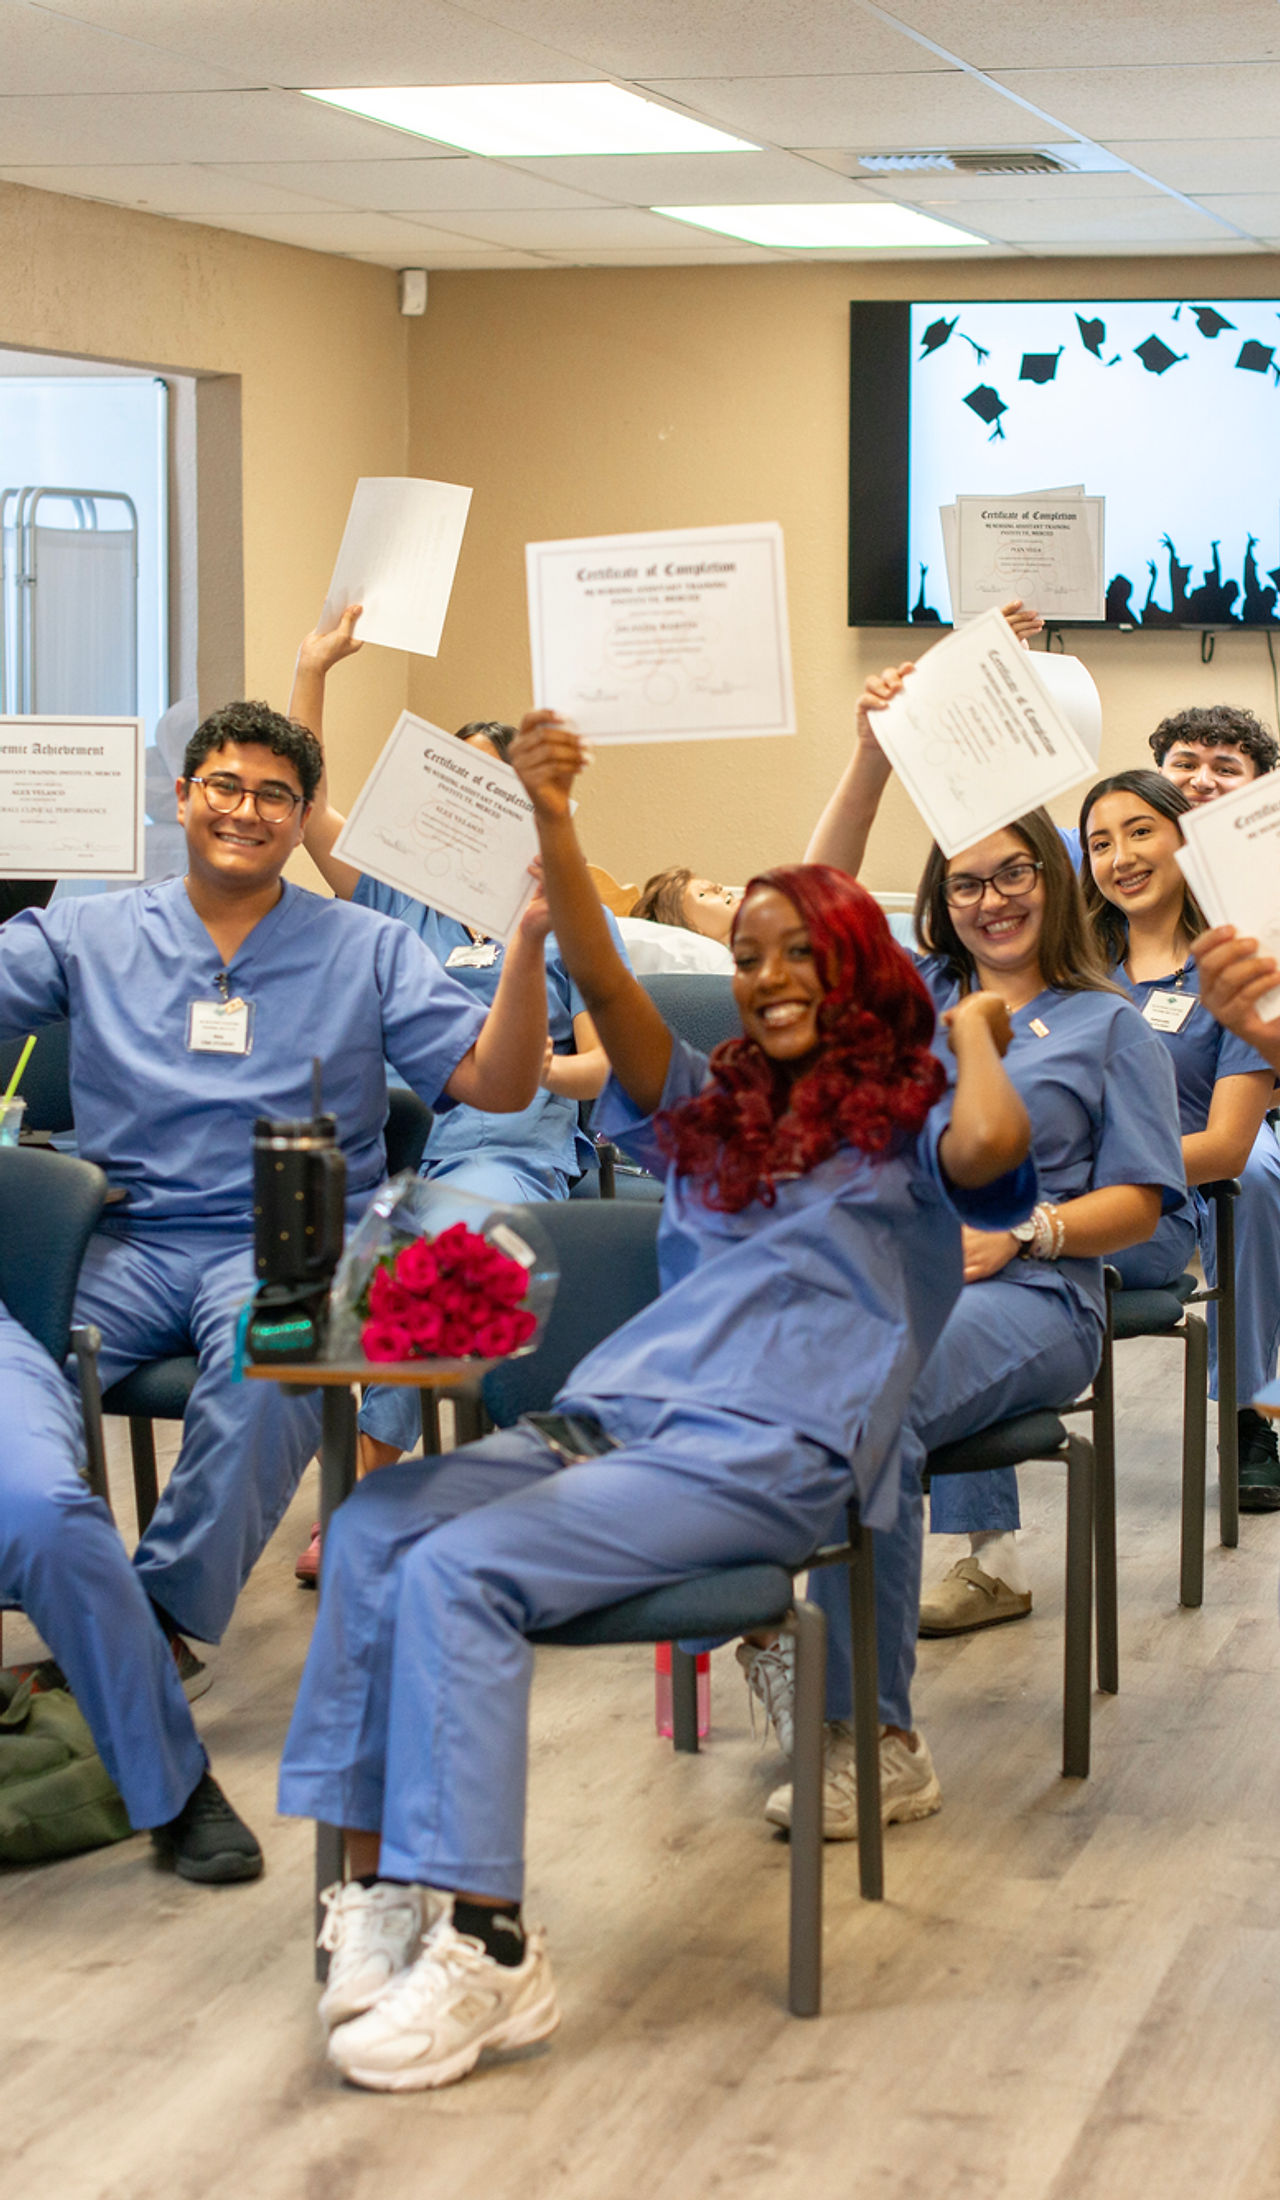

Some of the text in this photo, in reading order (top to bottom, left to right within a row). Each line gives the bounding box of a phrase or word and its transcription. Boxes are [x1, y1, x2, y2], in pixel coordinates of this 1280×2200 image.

[981, 510, 1077, 520] Certificate of Completion
[576, 561, 736, 581] Certificate of Completion
[0, 743, 104, 755] emic Achievement
[424, 749, 469, 777] Certificate
[472, 776, 483, 784] of
